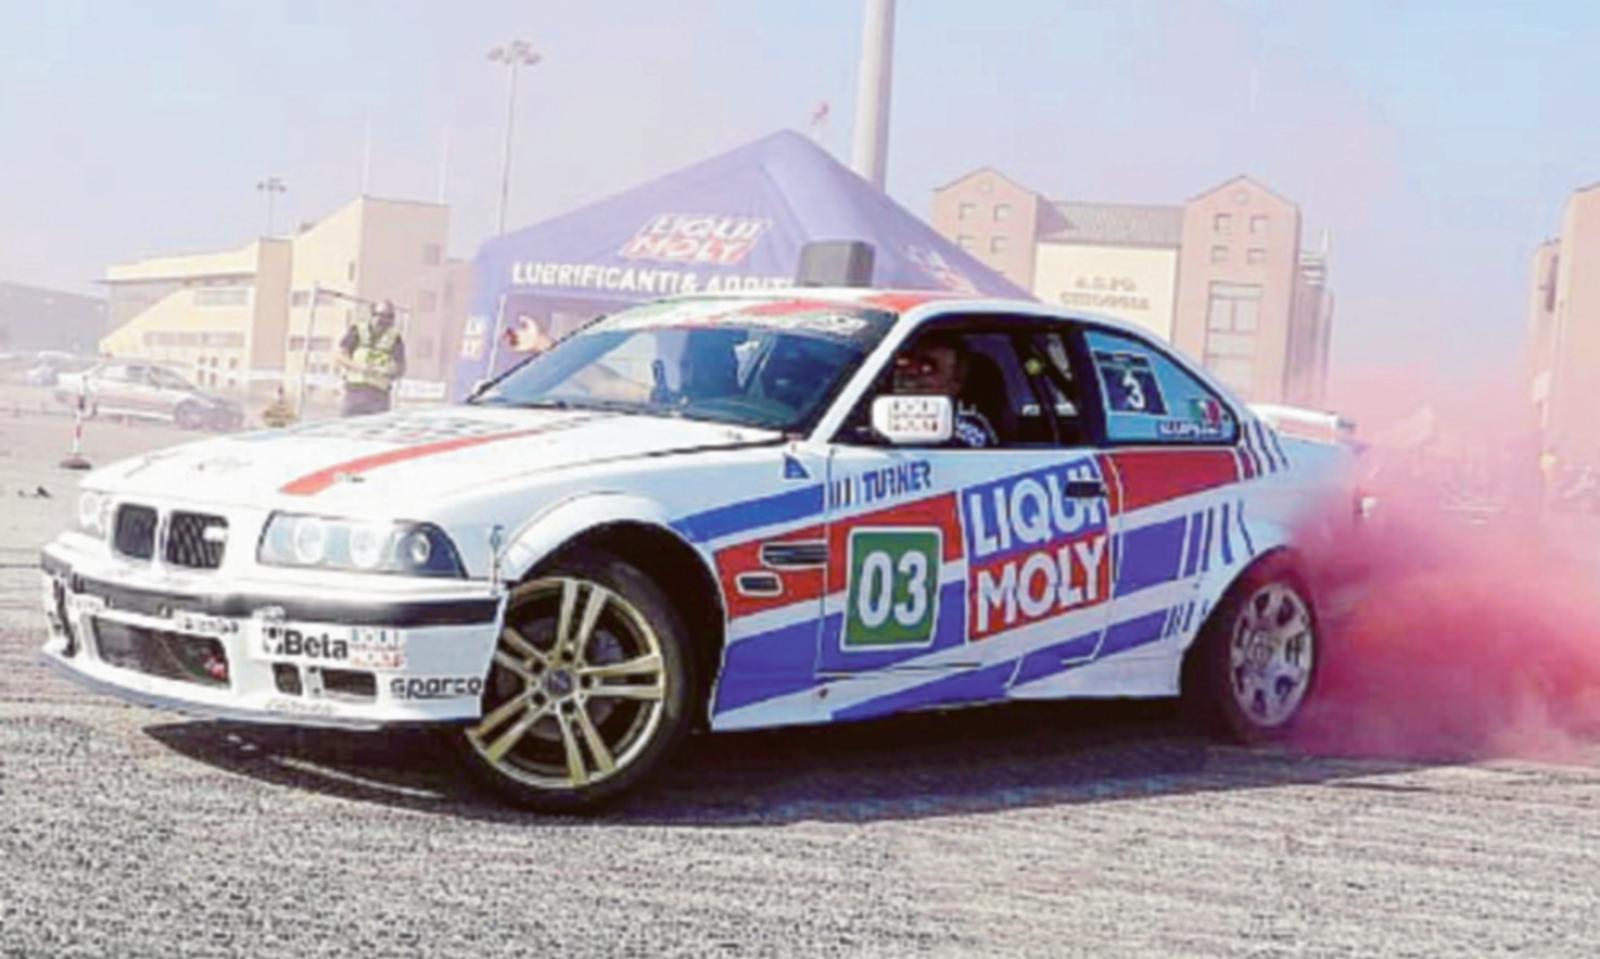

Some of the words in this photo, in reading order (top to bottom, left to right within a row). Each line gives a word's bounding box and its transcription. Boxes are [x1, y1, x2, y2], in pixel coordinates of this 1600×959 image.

[1122, 369, 1145, 409] 3
[862, 459, 931, 502] TURNER
[858, 550, 927, 628] 03
[977, 535, 1106, 632] MOLY
[284, 627, 348, 660] Beta
[390, 676, 482, 700] sparco
